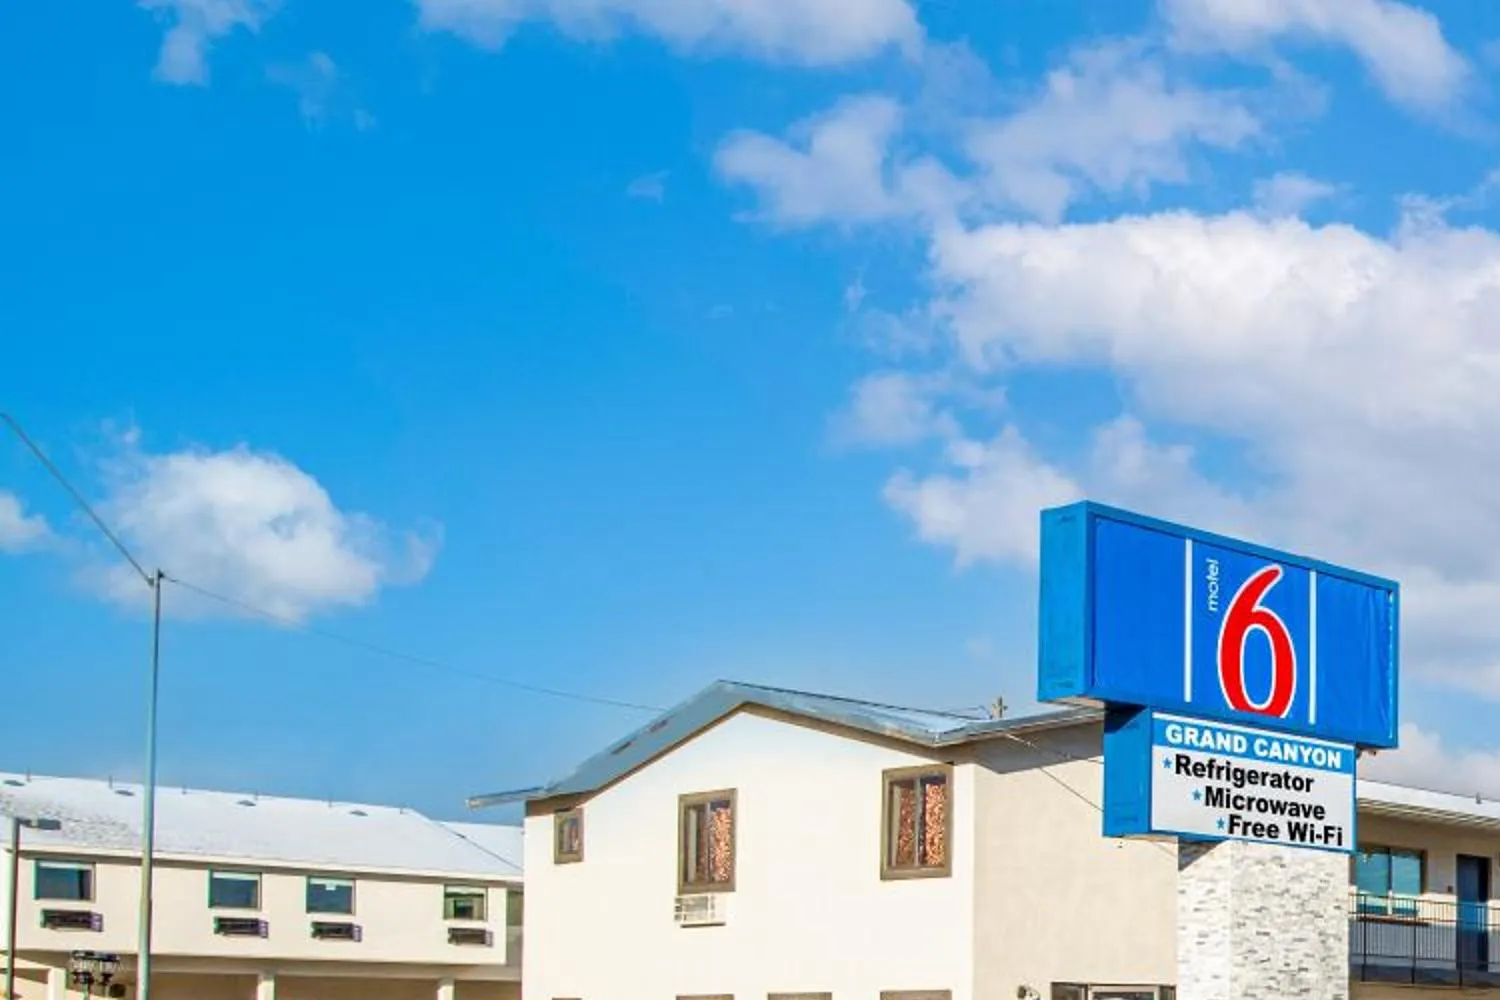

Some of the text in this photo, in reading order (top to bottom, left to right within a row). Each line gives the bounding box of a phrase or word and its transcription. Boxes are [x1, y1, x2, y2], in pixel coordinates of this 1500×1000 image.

[1206, 557, 1220, 612] motel
[1217, 564, 1297, 719] 6
[1165, 723, 1342, 769] GRAND CANYON
[1174, 753, 1315, 793] Refrigerator
[1204, 785, 1327, 821] Microwave
[1228, 813, 1343, 847] Free Wi-Fi
